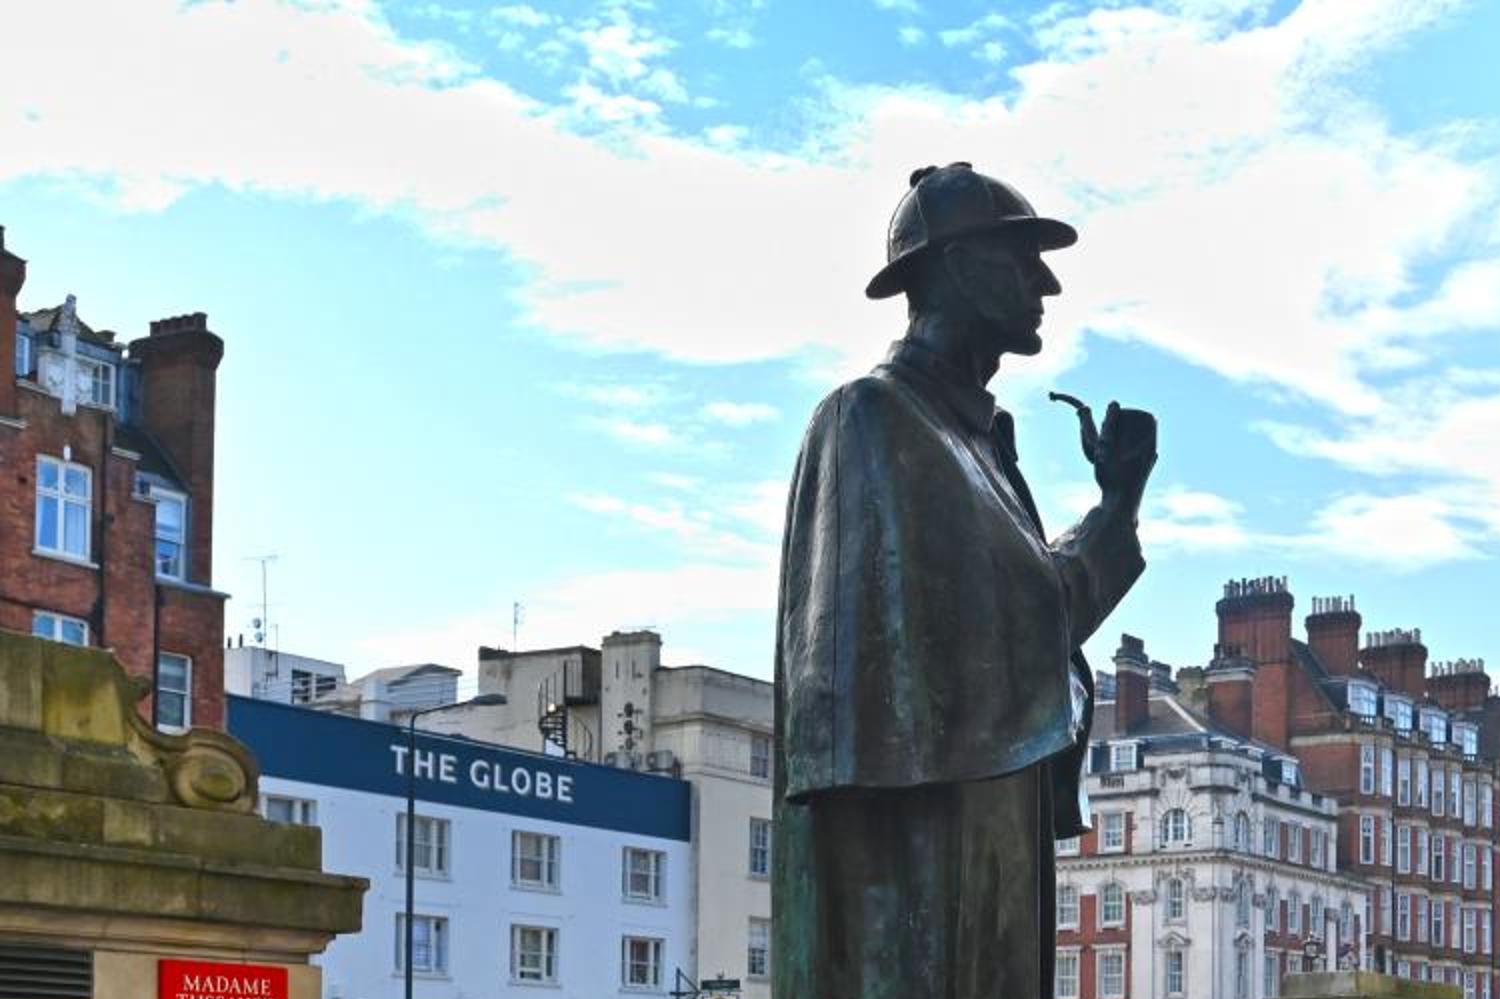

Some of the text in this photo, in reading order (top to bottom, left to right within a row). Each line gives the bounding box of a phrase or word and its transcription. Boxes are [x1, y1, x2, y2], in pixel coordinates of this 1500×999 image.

[389, 744, 575, 803] THE GLOBE
[184, 974, 271, 996] MADAME
